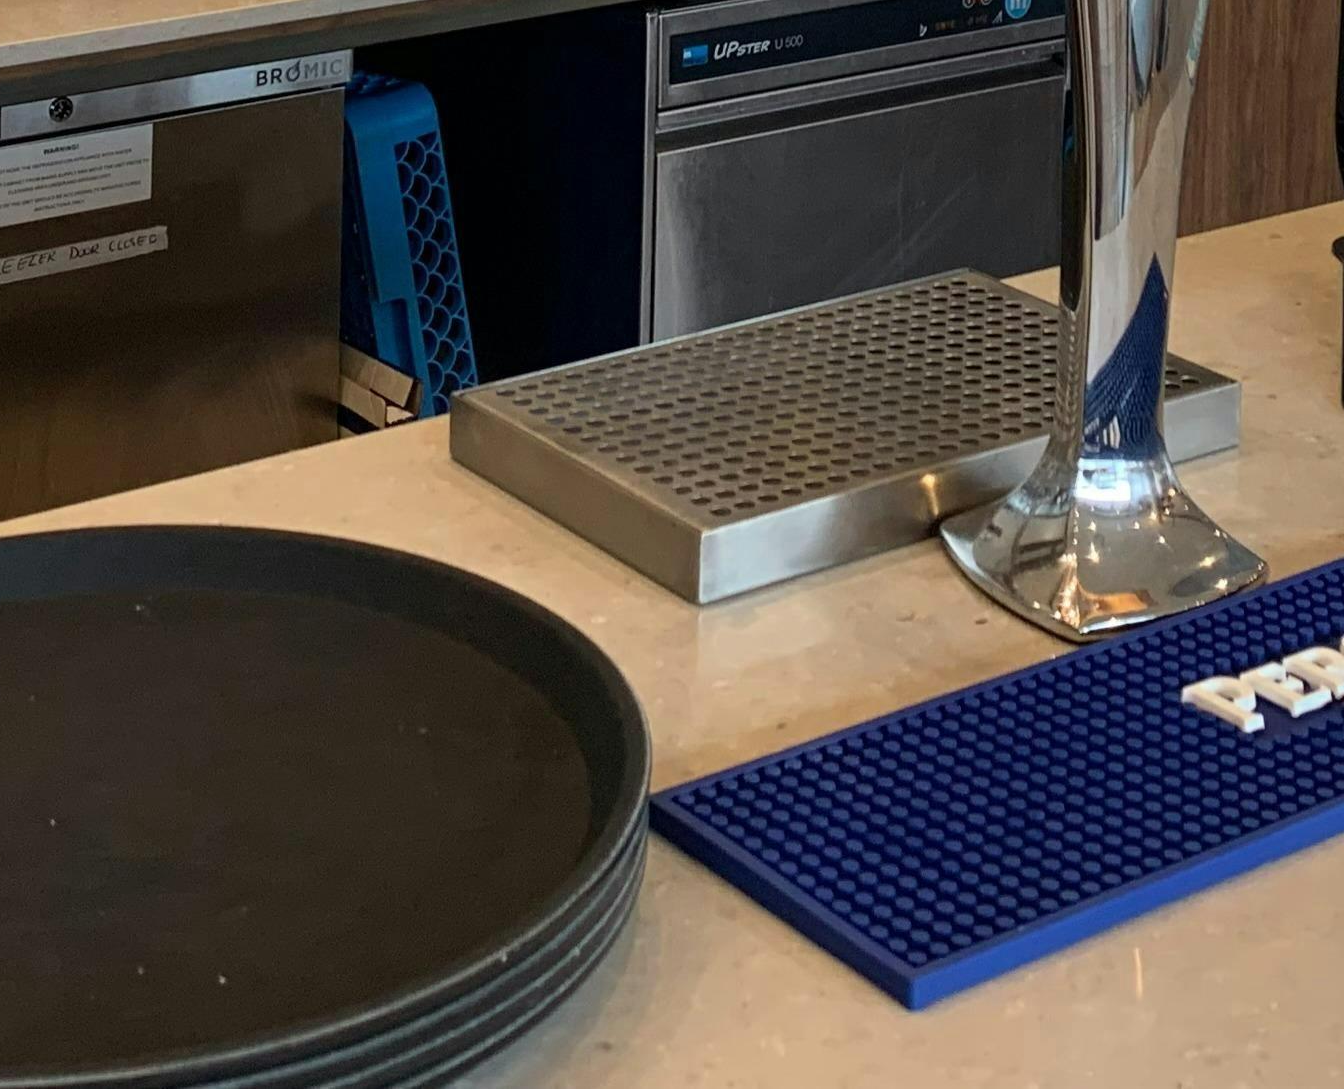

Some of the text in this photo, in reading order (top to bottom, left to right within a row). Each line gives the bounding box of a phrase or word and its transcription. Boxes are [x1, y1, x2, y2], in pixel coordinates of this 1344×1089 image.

[774, 39, 783, 50] U
[785, 34, 804, 49] 500
[256, 58, 343, 87] BROMIC
[108, 233, 158, 252] CLOSED
